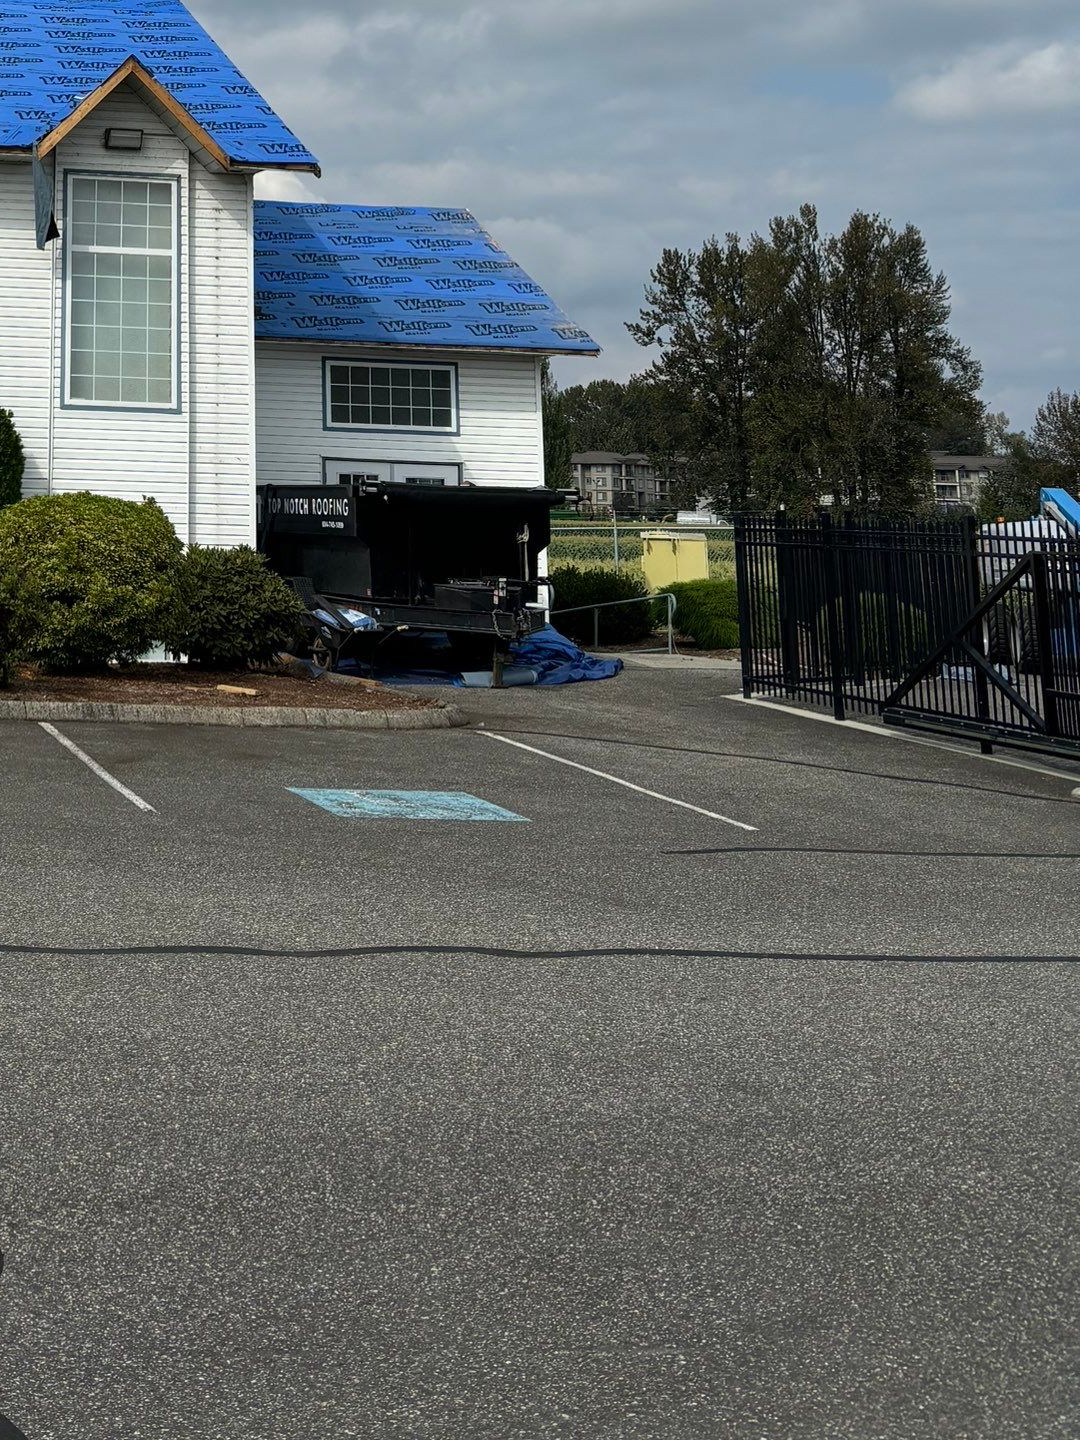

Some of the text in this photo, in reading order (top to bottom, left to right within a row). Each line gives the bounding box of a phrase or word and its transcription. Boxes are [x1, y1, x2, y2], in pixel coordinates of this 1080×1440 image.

[268, 498, 349, 516] TOP NOTCH ROOFING
